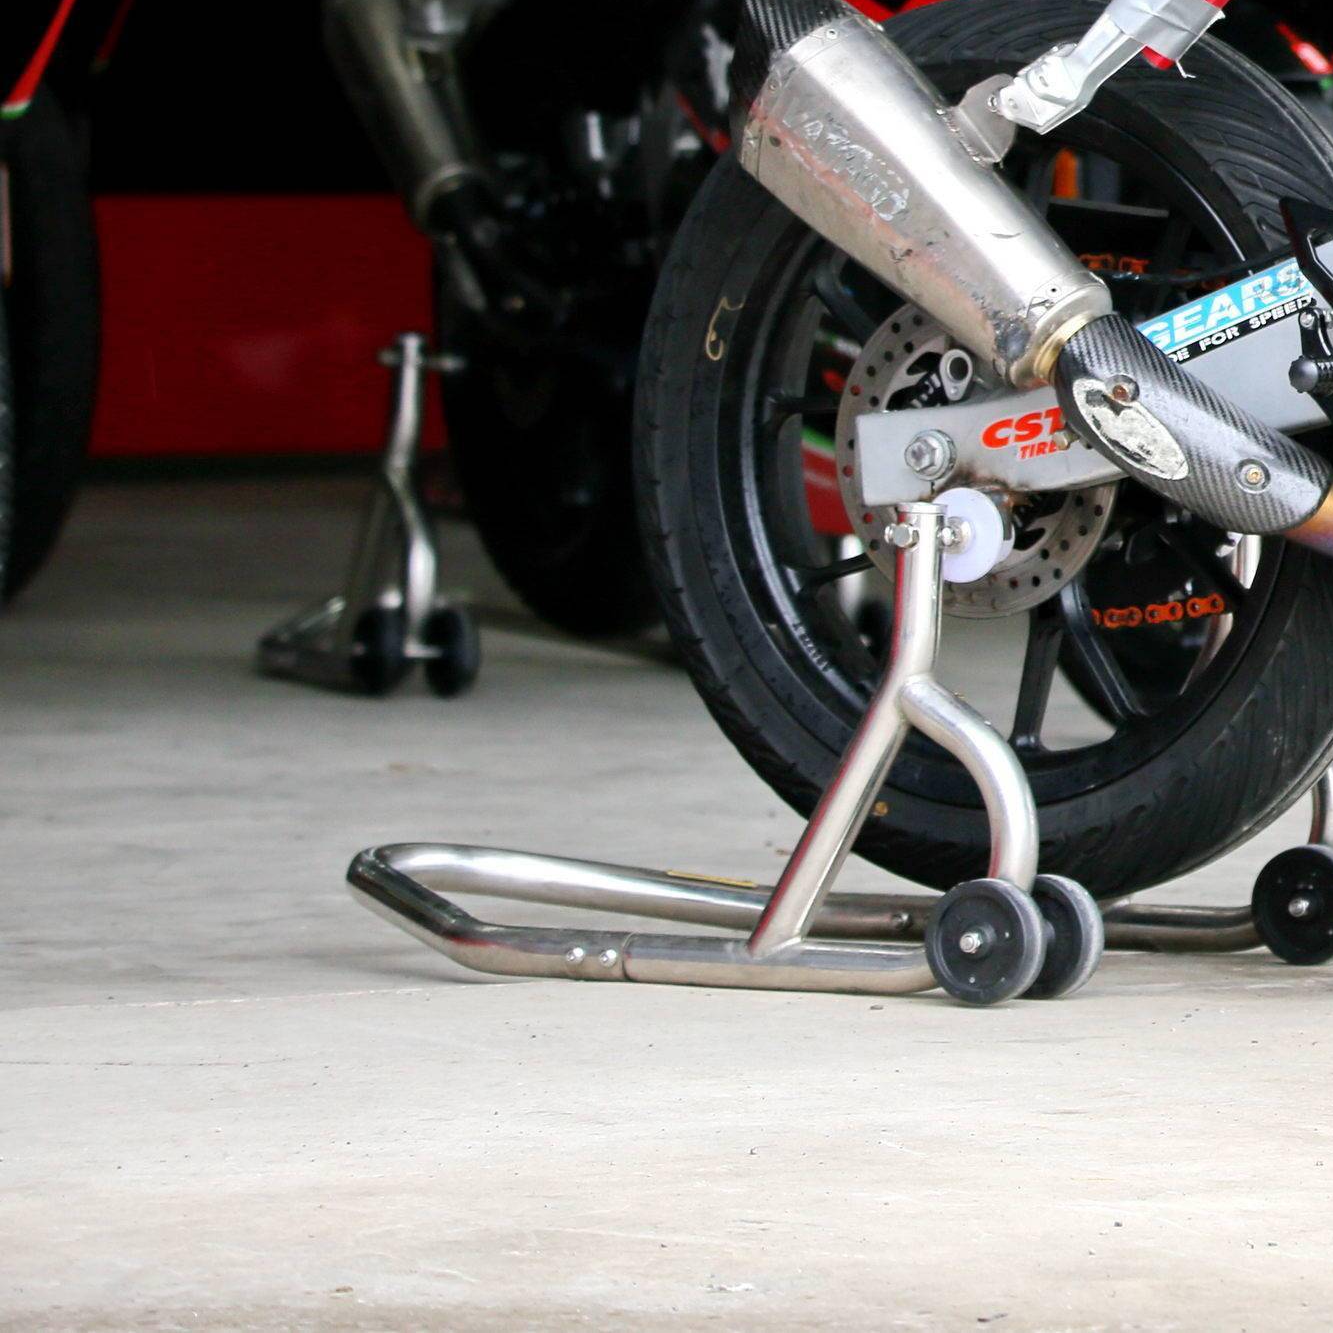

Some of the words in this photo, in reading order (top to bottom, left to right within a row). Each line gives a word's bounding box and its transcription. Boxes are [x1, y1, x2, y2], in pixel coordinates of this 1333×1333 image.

[1198, 325, 1241, 352] FOR
[1248, 295, 1312, 331] SPEED
[981, 406, 1065, 449] CST
